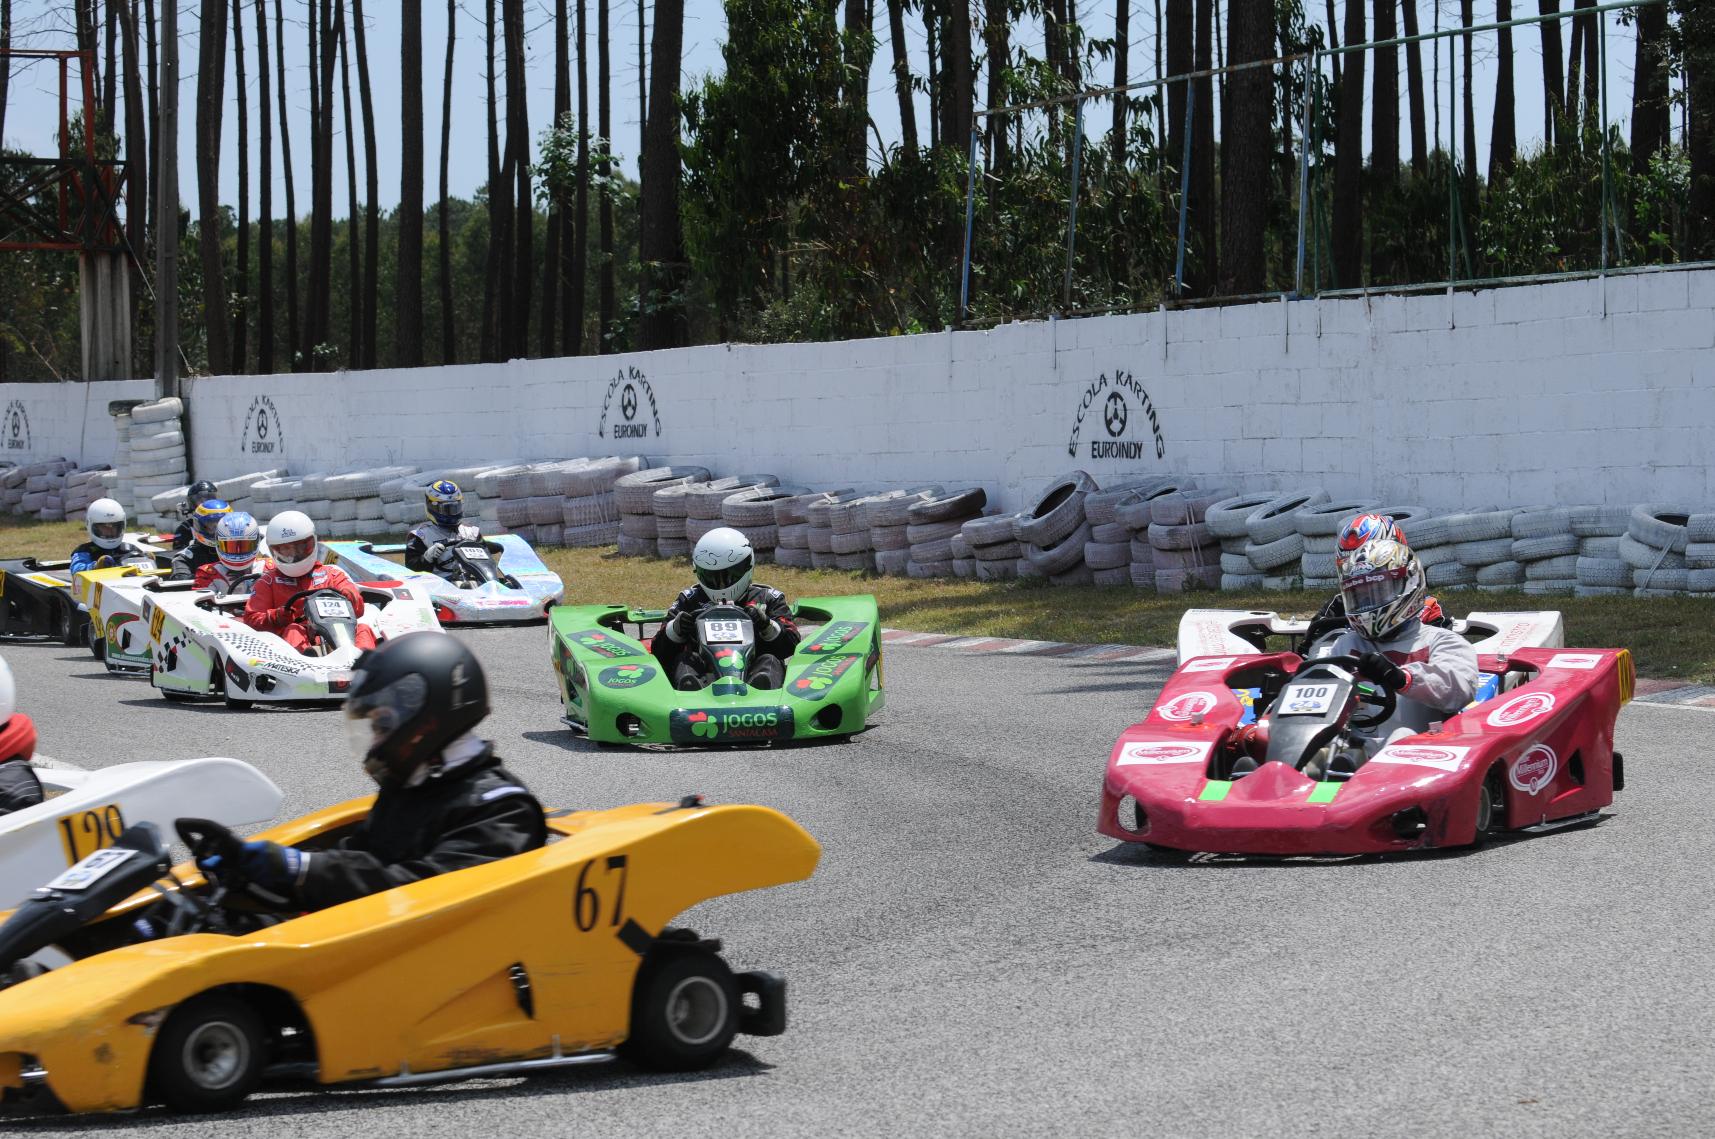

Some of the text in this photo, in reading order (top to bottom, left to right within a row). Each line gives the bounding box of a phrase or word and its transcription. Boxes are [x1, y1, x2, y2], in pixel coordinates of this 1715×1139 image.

[599, 365, 662, 438] ESCOLA KARTING
[1068, 369, 1165, 459] ESCOLA KARTING
[614, 423, 648, 439] EUROINDY
[1091, 440, 1143, 459] EUROINDY
[1365, 574, 1385, 583] bcp
[710, 622, 738, 632] 89
[812, 654, 847, 677] JOGOS
[607, 677, 637, 685] JOGOS
[1295, 687, 1328, 699] 100
[722, 712, 778, 734] JOGOS
[84, 850, 127, 869] 67
[574, 853, 628, 933] 67
